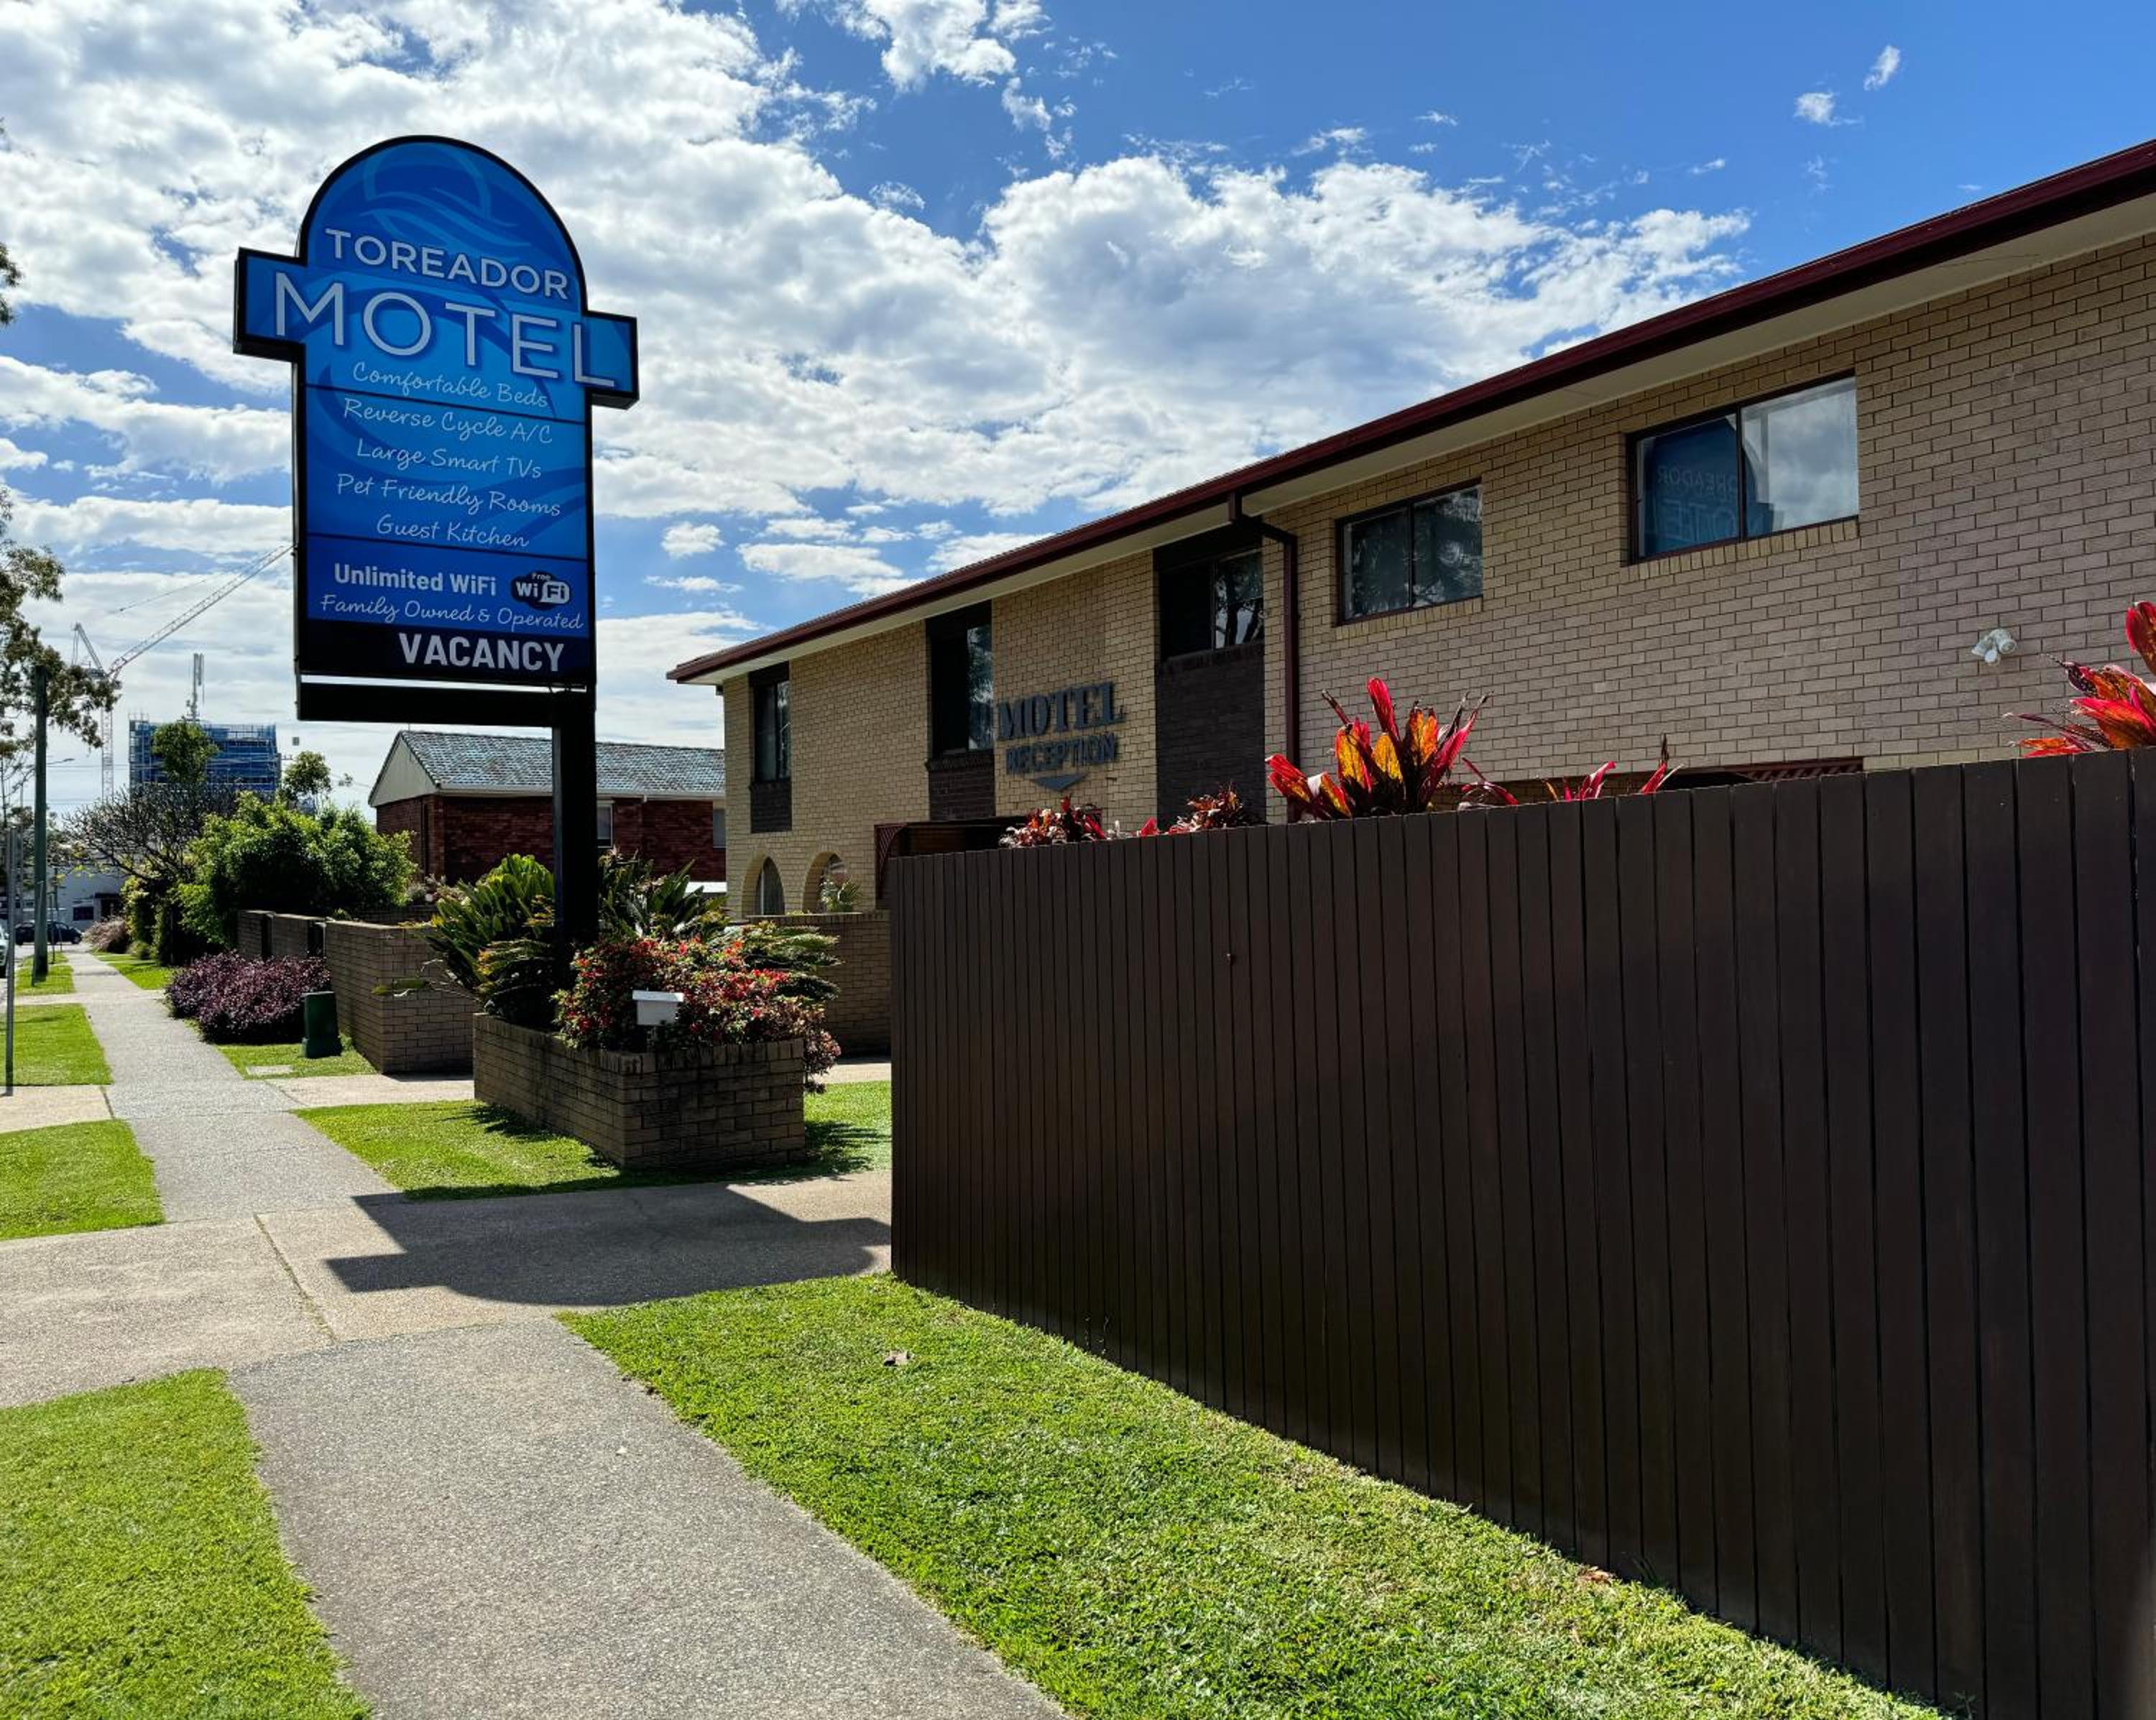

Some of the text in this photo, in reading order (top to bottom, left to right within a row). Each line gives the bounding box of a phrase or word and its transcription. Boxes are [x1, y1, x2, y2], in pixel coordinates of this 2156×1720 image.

[324, 227, 570, 300] TOREADOR
[275, 272, 616, 388] MOTEL
[352, 361, 549, 408] Comfortable Beds
[343, 397, 553, 444] Reverse Cycle A/C
[356, 437, 542, 479] Large Smart TVs
[336, 473, 562, 517] Pet Friendly Rooms
[376, 513, 530, 548] Guest Kitchen
[333, 562, 497, 597] Unlimited WiFi
[321, 593, 584, 633] Family Owned & Operated
[398, 632, 566, 672] VACANCY
[998, 681, 1127, 741] MOTEL
[1006, 731, 1118, 775] RECEPTION
